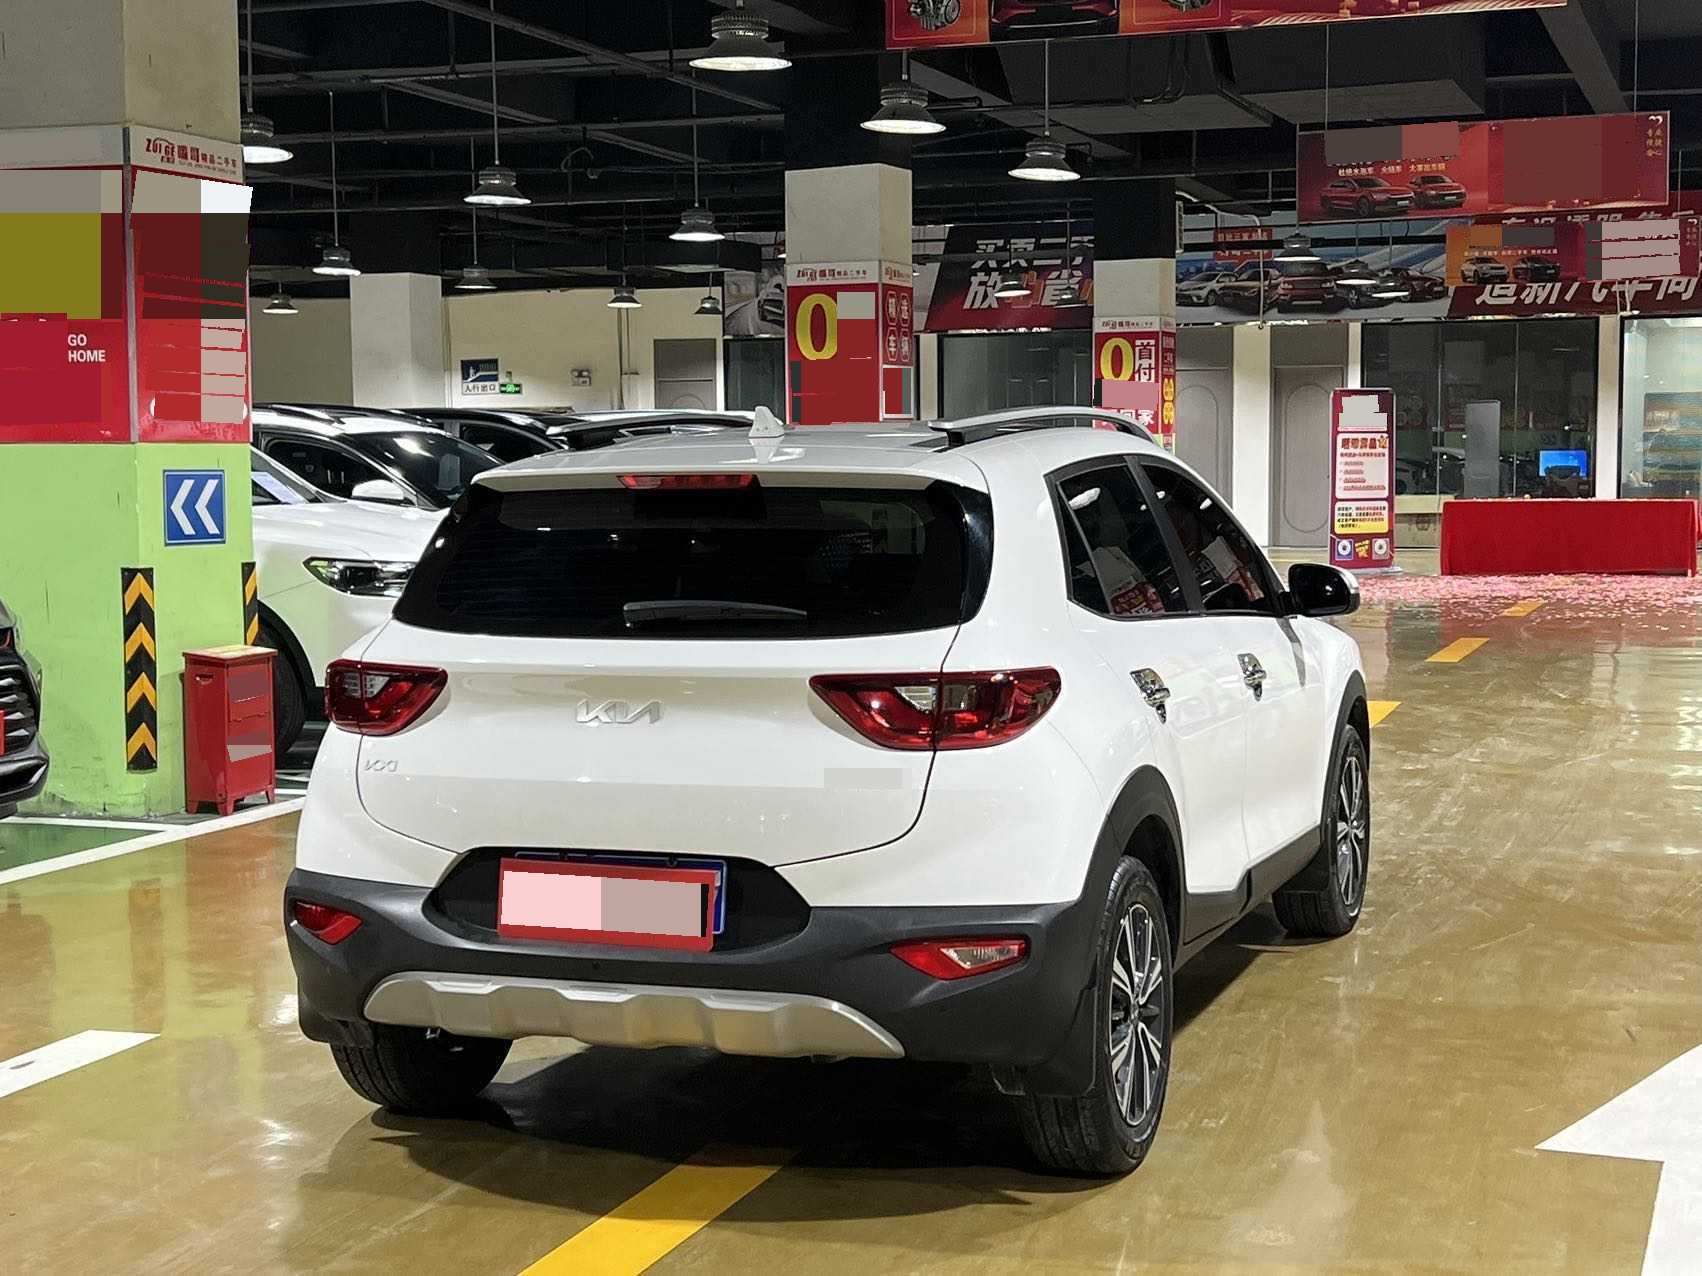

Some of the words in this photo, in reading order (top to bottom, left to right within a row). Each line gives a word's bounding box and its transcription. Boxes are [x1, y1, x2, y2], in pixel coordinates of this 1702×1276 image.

[67, 333, 88, 347] GO
[68, 349, 106, 363] HOME
[575, 698, 661, 725] KIA
